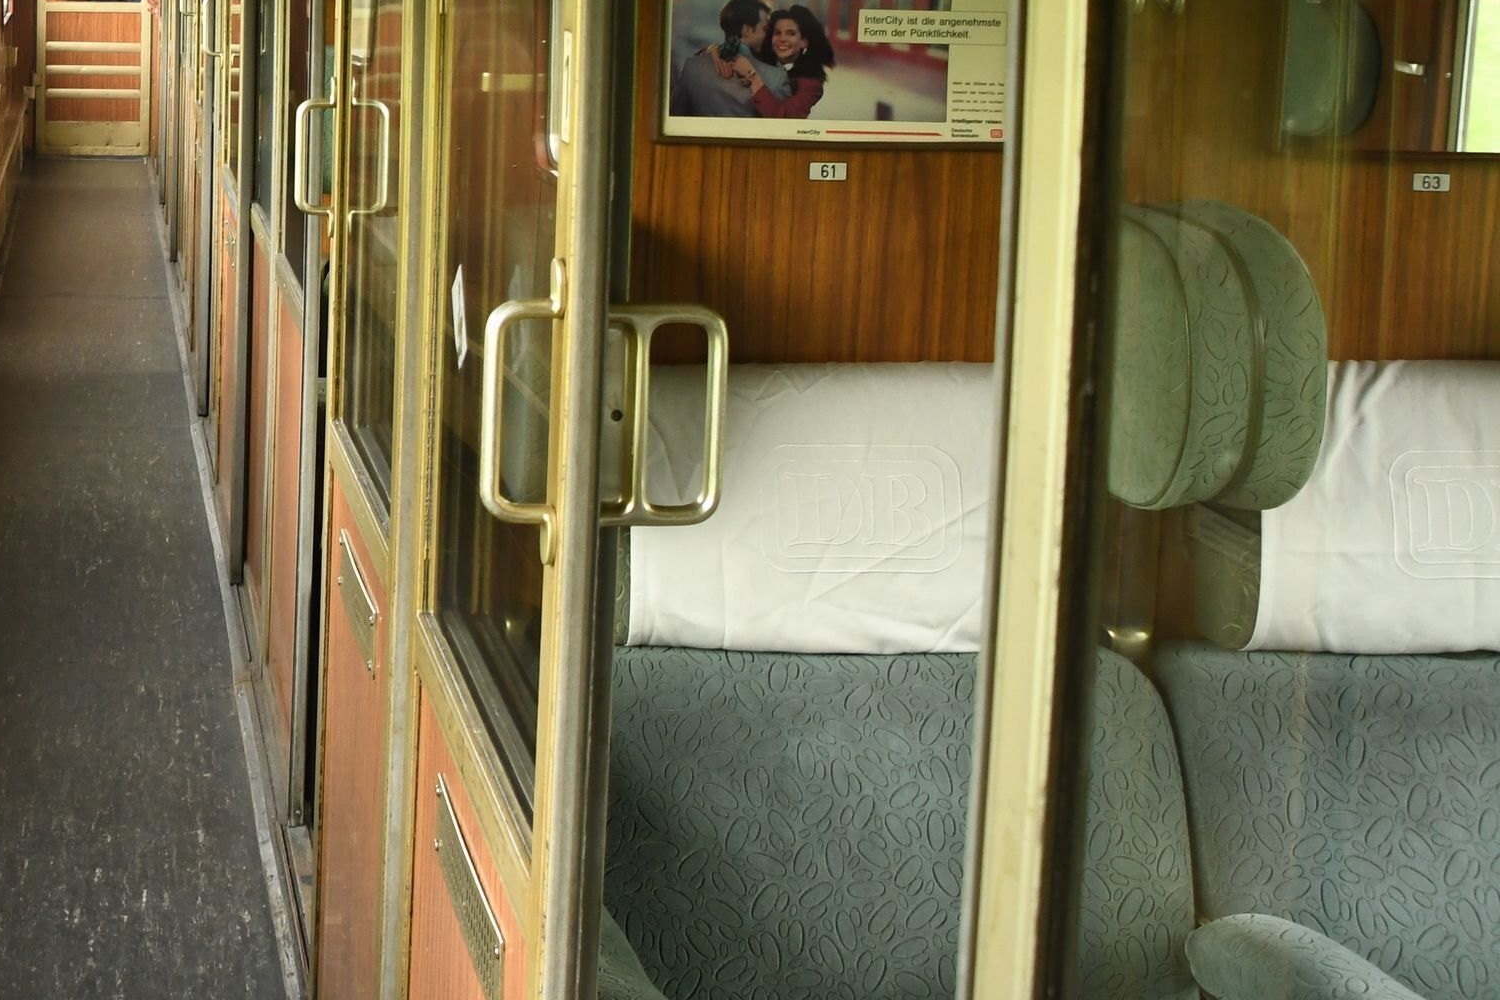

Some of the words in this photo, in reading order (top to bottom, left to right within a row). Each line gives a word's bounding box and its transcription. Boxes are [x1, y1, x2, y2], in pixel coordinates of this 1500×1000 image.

[864, 15, 903, 26] InterCity
[907, 15, 917, 25] ist
[921, 16, 935, 26] die
[939, 17, 1001, 28] angenehmste
[864, 27, 887, 37] Form
[891, 28, 906, 37] der
[820, 164, 836, 179] 61
[1422, 175, 1441, 190] 63
[784, 472, 932, 548] DB
[1412, 476, 1500, 552] D
